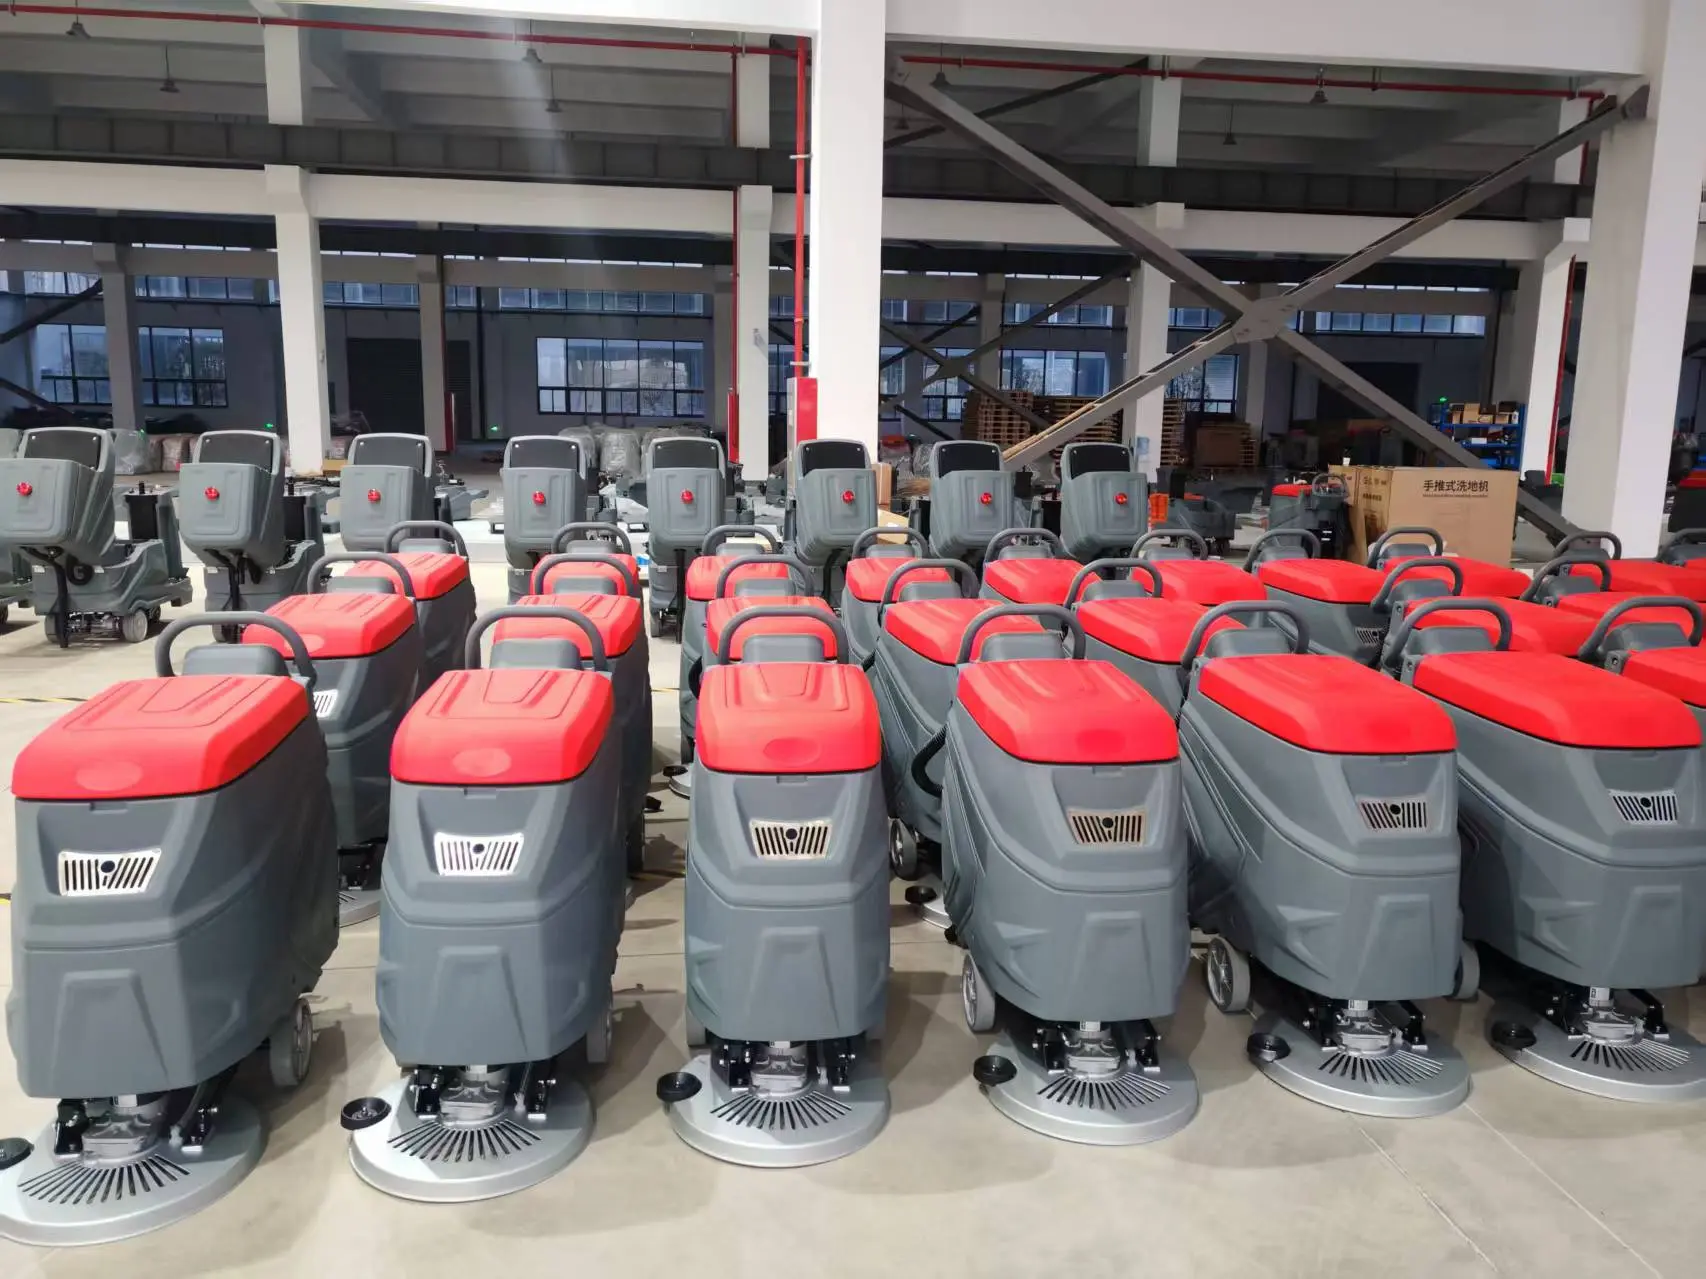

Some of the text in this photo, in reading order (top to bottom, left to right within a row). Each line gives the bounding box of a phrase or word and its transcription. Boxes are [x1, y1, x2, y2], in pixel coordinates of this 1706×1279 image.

[1423, 480, 1489, 492] 手推式洗地机
